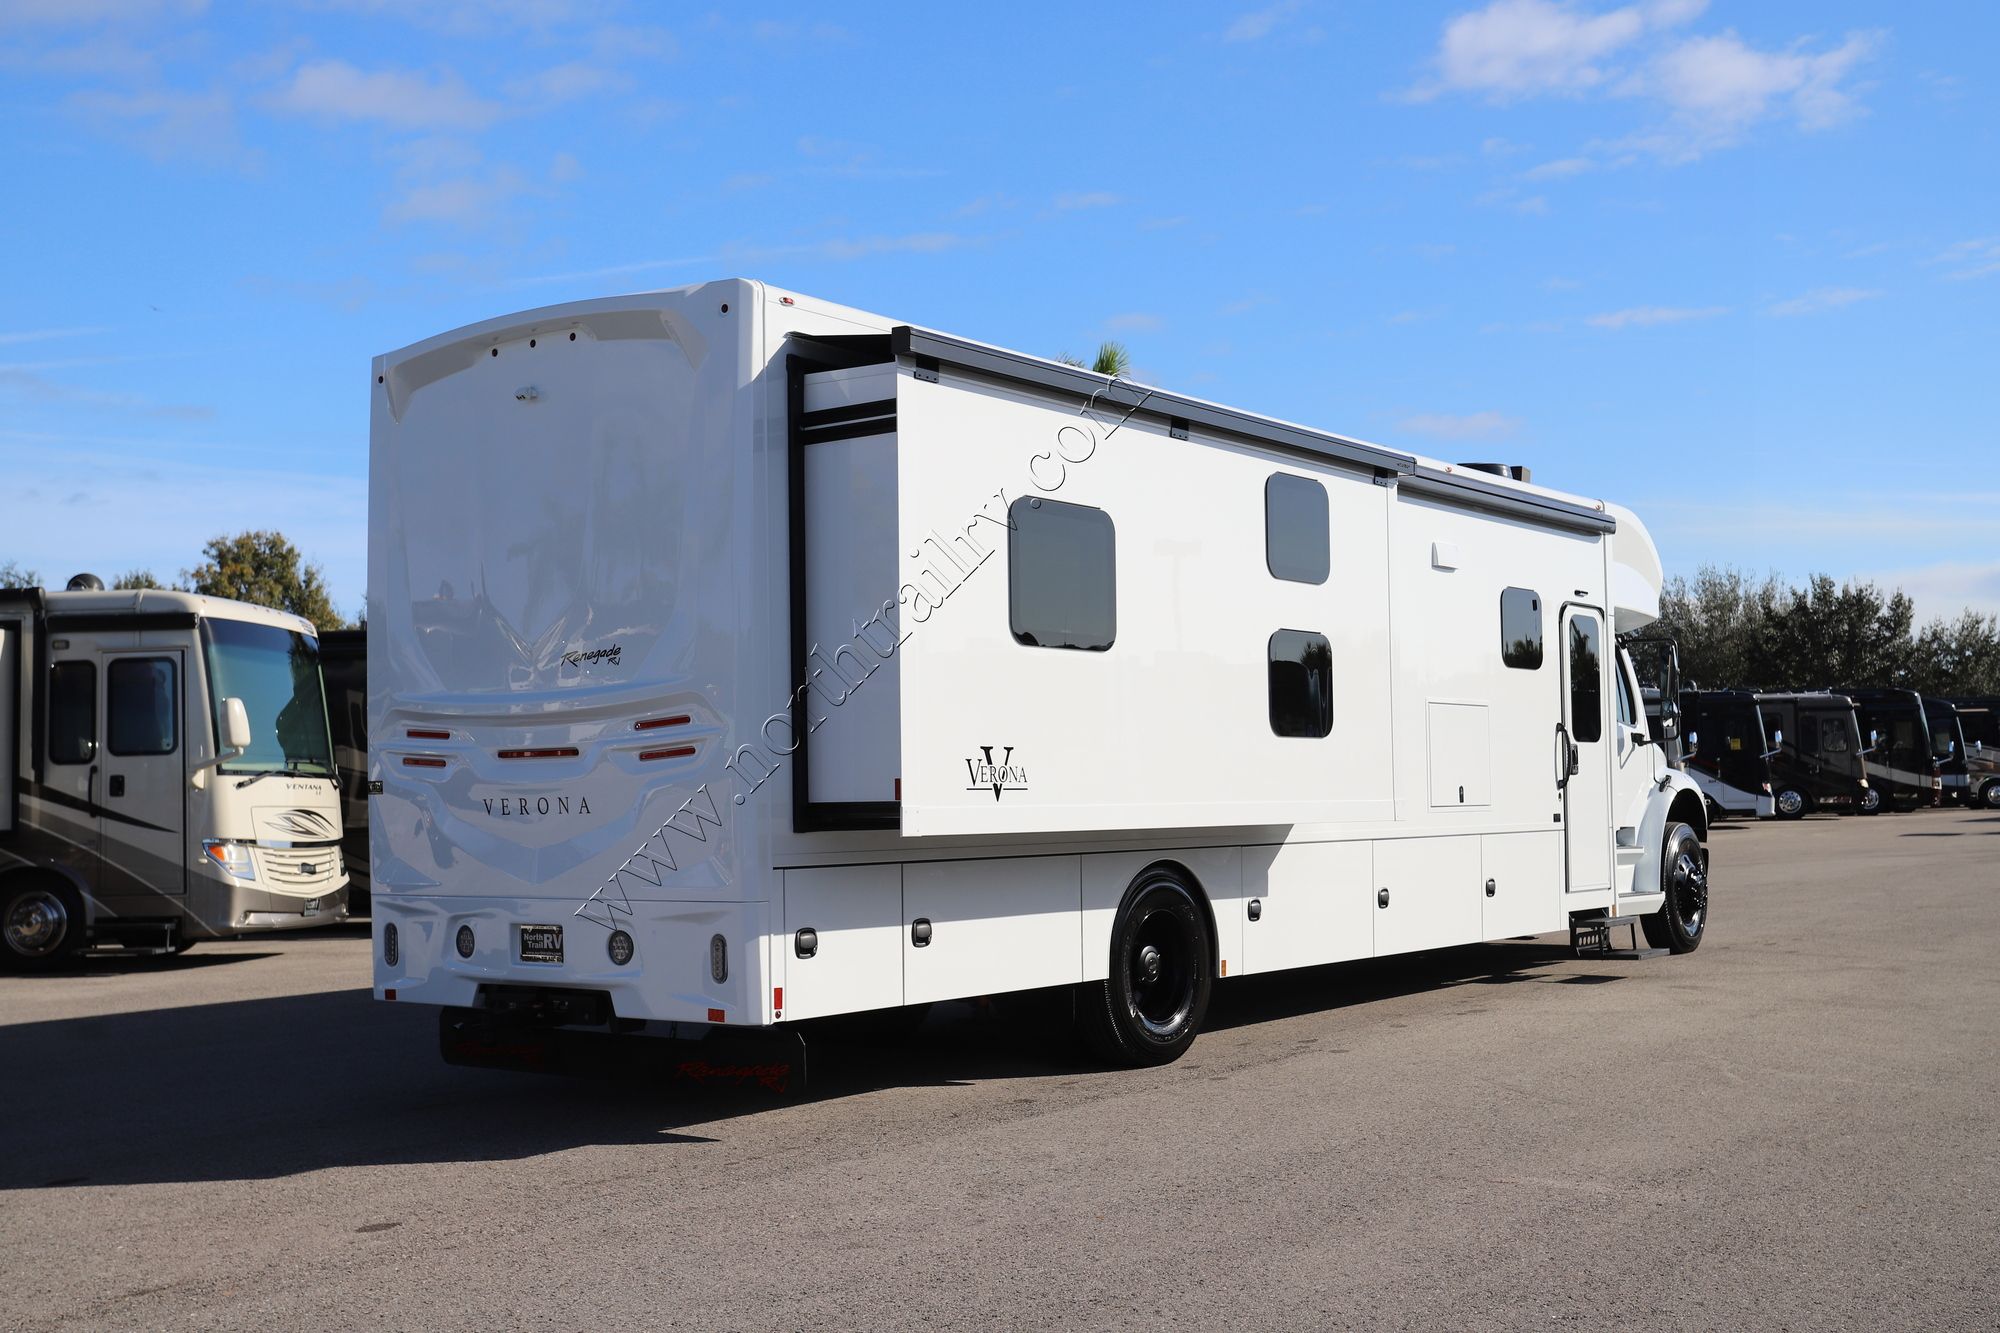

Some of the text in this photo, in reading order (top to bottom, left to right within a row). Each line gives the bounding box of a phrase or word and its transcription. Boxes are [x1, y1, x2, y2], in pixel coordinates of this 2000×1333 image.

[560, 643, 621, 667] Renegade
[607, 656, 621, 665] RV
[965, 758, 1028, 787] VERONA
[483, 796, 591, 816] VERONA
[523, 933, 543, 941] North
[543, 933, 562, 949] RV
